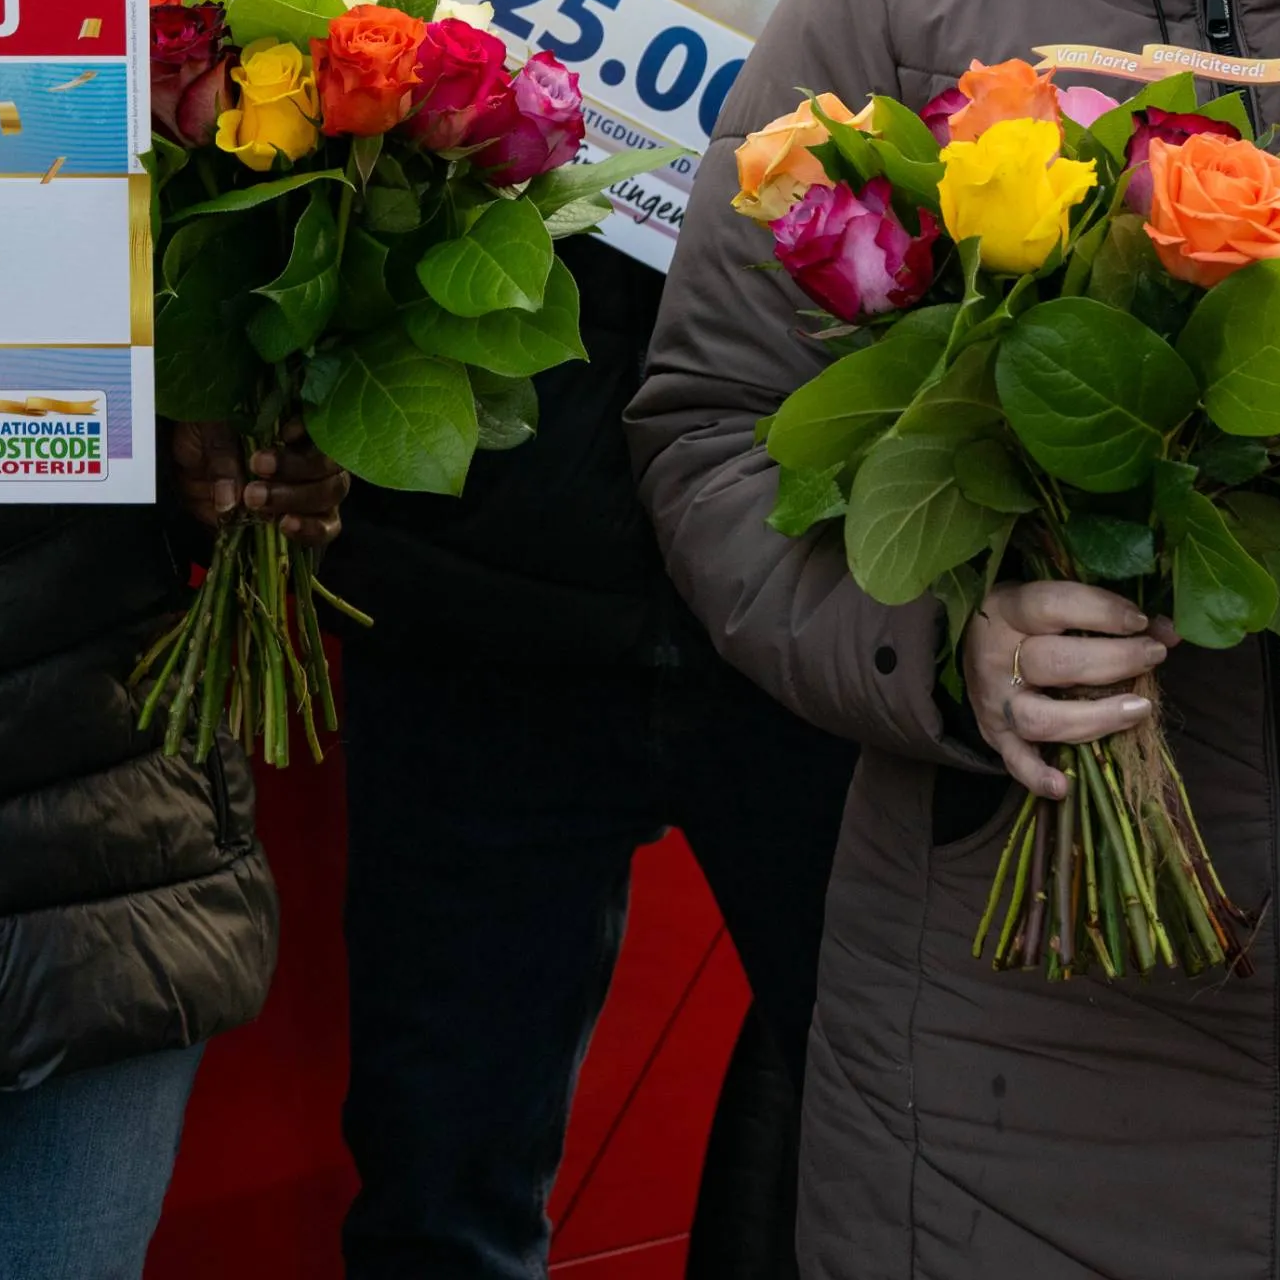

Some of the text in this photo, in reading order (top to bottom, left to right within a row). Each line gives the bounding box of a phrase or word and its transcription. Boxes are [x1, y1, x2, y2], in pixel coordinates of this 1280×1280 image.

[1056, 47, 1266, 78] Van harte gefeliciteerd!
